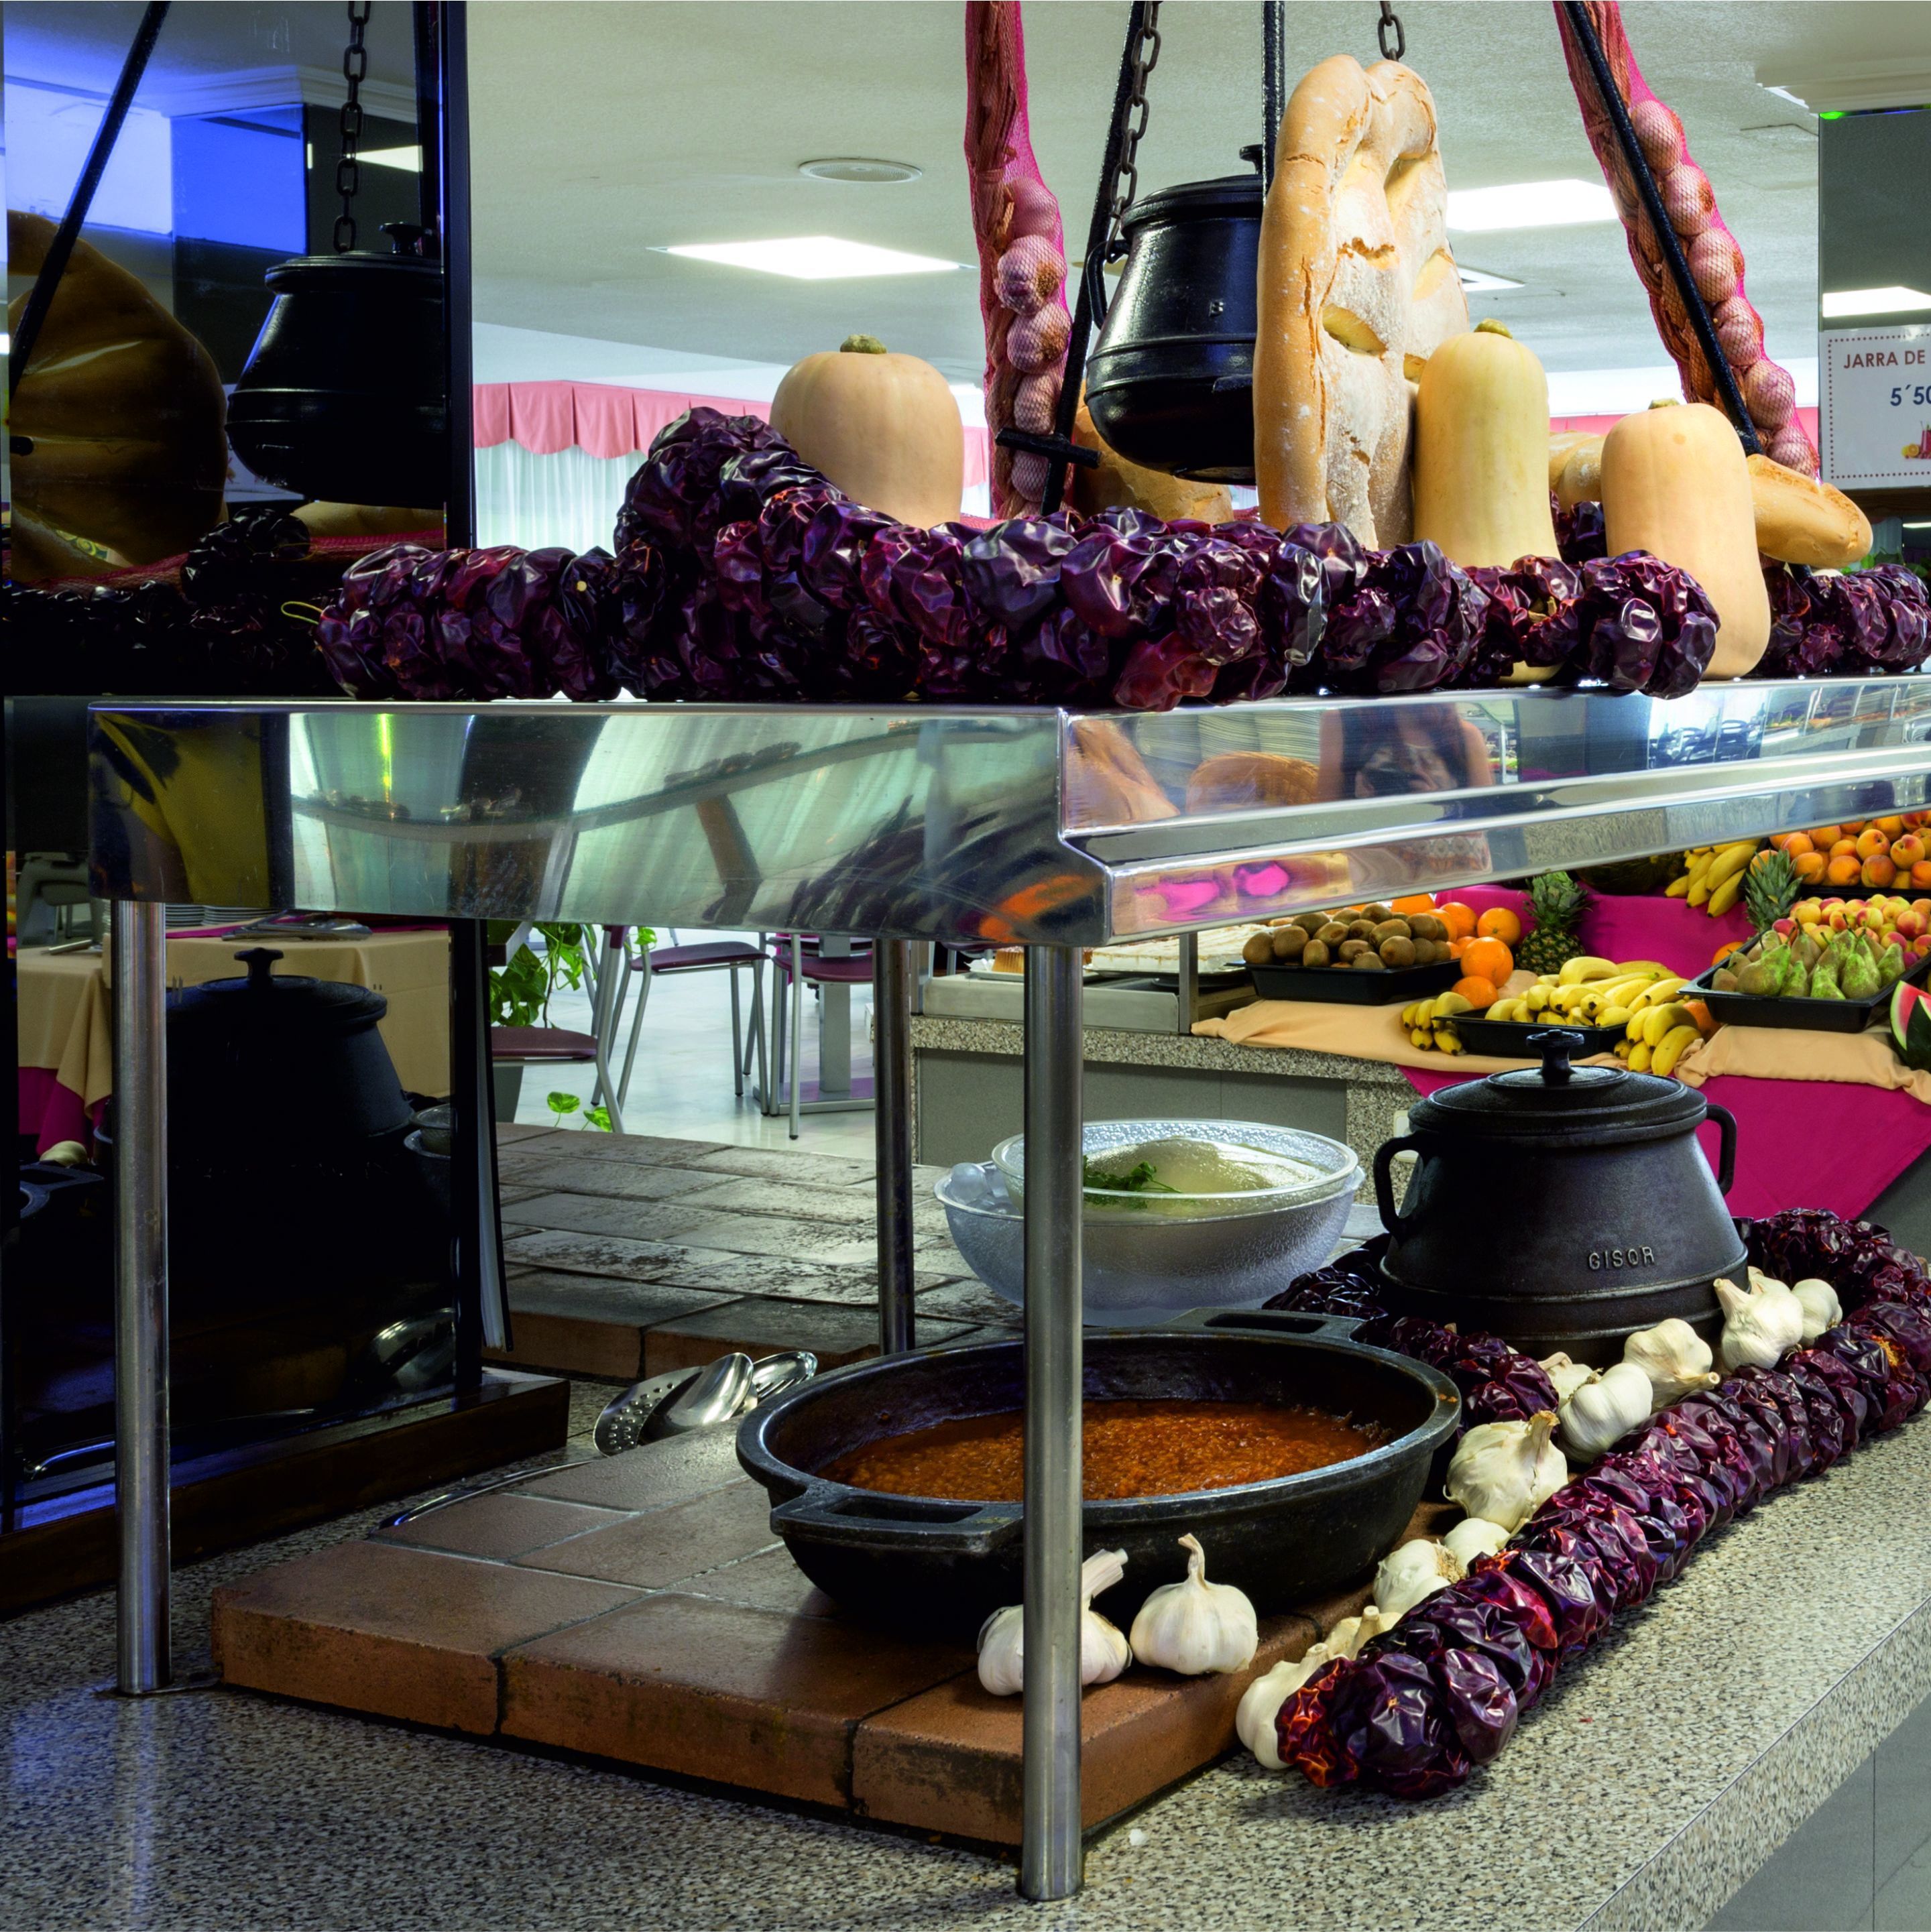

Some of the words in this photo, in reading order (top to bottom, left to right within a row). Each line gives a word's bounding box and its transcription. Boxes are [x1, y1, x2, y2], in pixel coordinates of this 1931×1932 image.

[1844, 351, 1898, 369] JARRA
[1904, 349, 1926, 365] DE
[1588, 1246, 1655, 1270] GISOR
